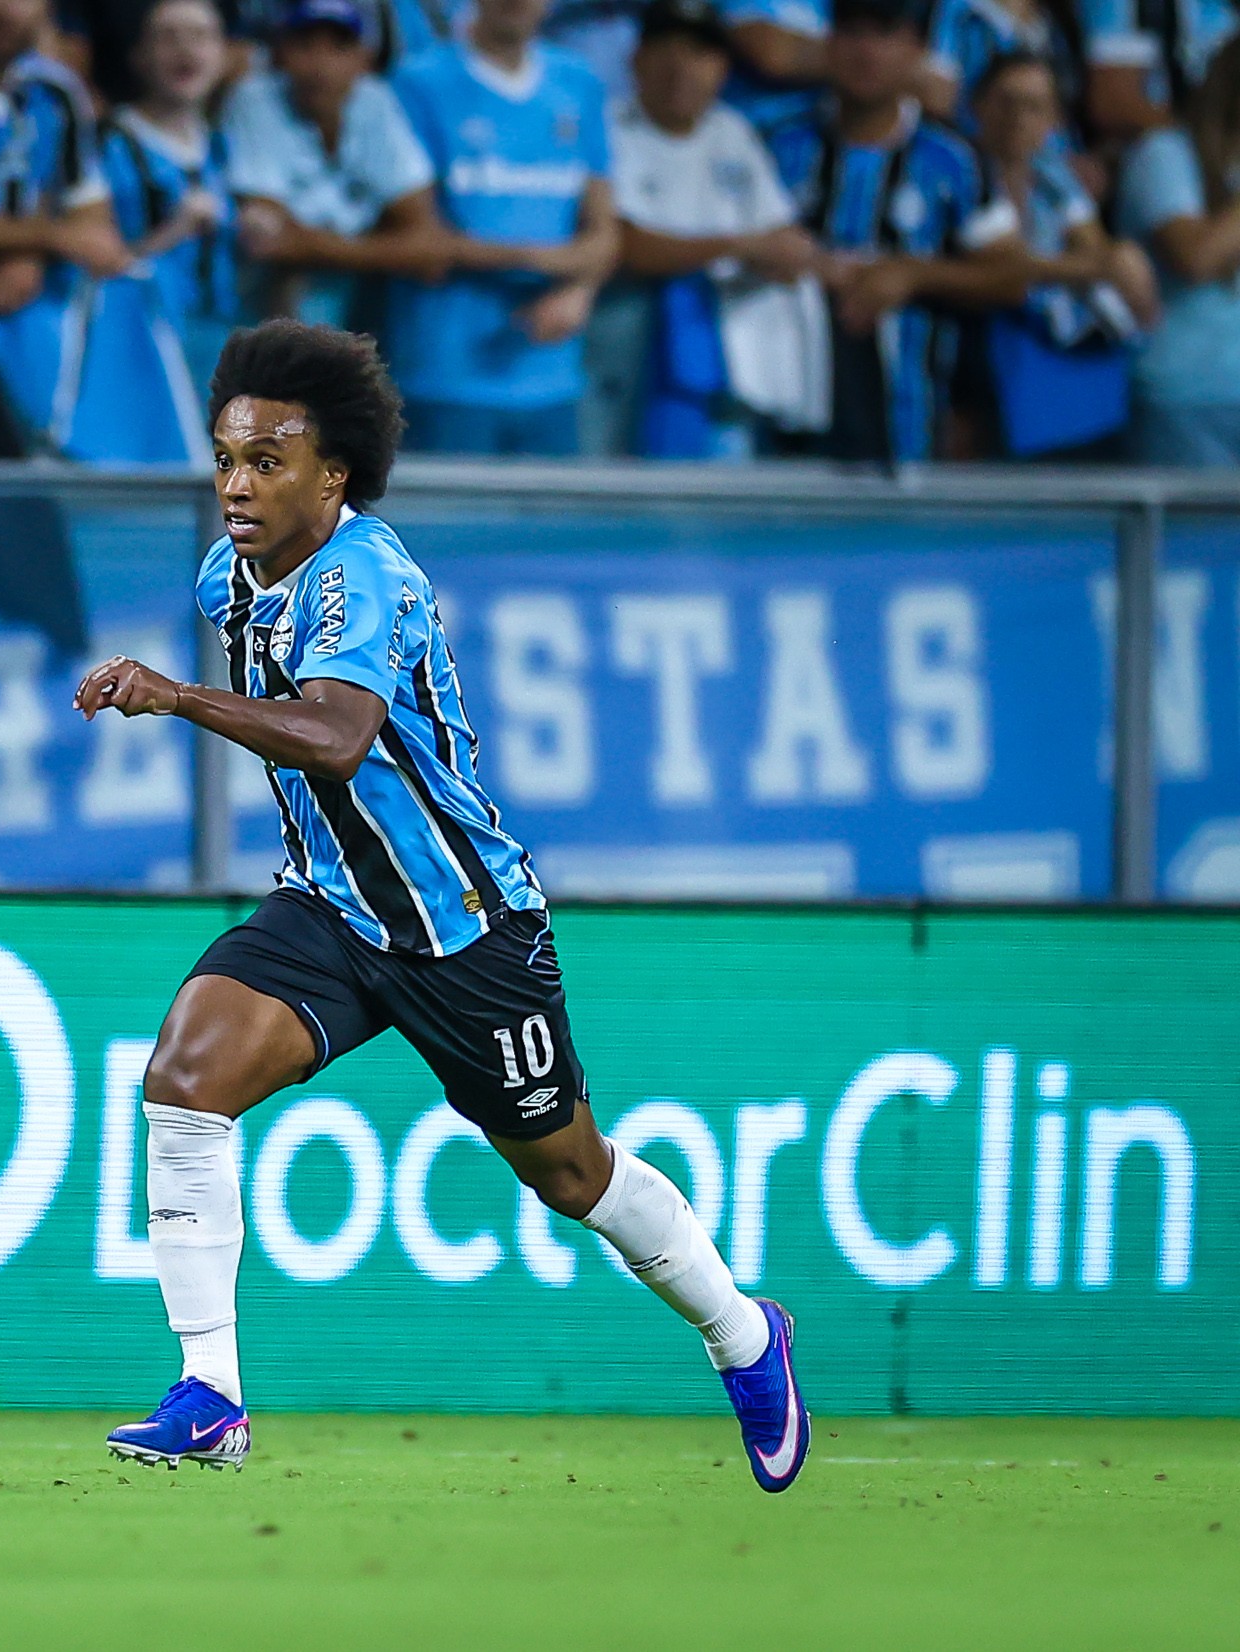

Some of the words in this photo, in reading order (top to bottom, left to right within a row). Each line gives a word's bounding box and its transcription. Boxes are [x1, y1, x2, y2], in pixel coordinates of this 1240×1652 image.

[313, 564, 347, 656] HAVAN
[493, 1014, 555, 1088] 10
[521, 1100, 559, 1119] umbro
